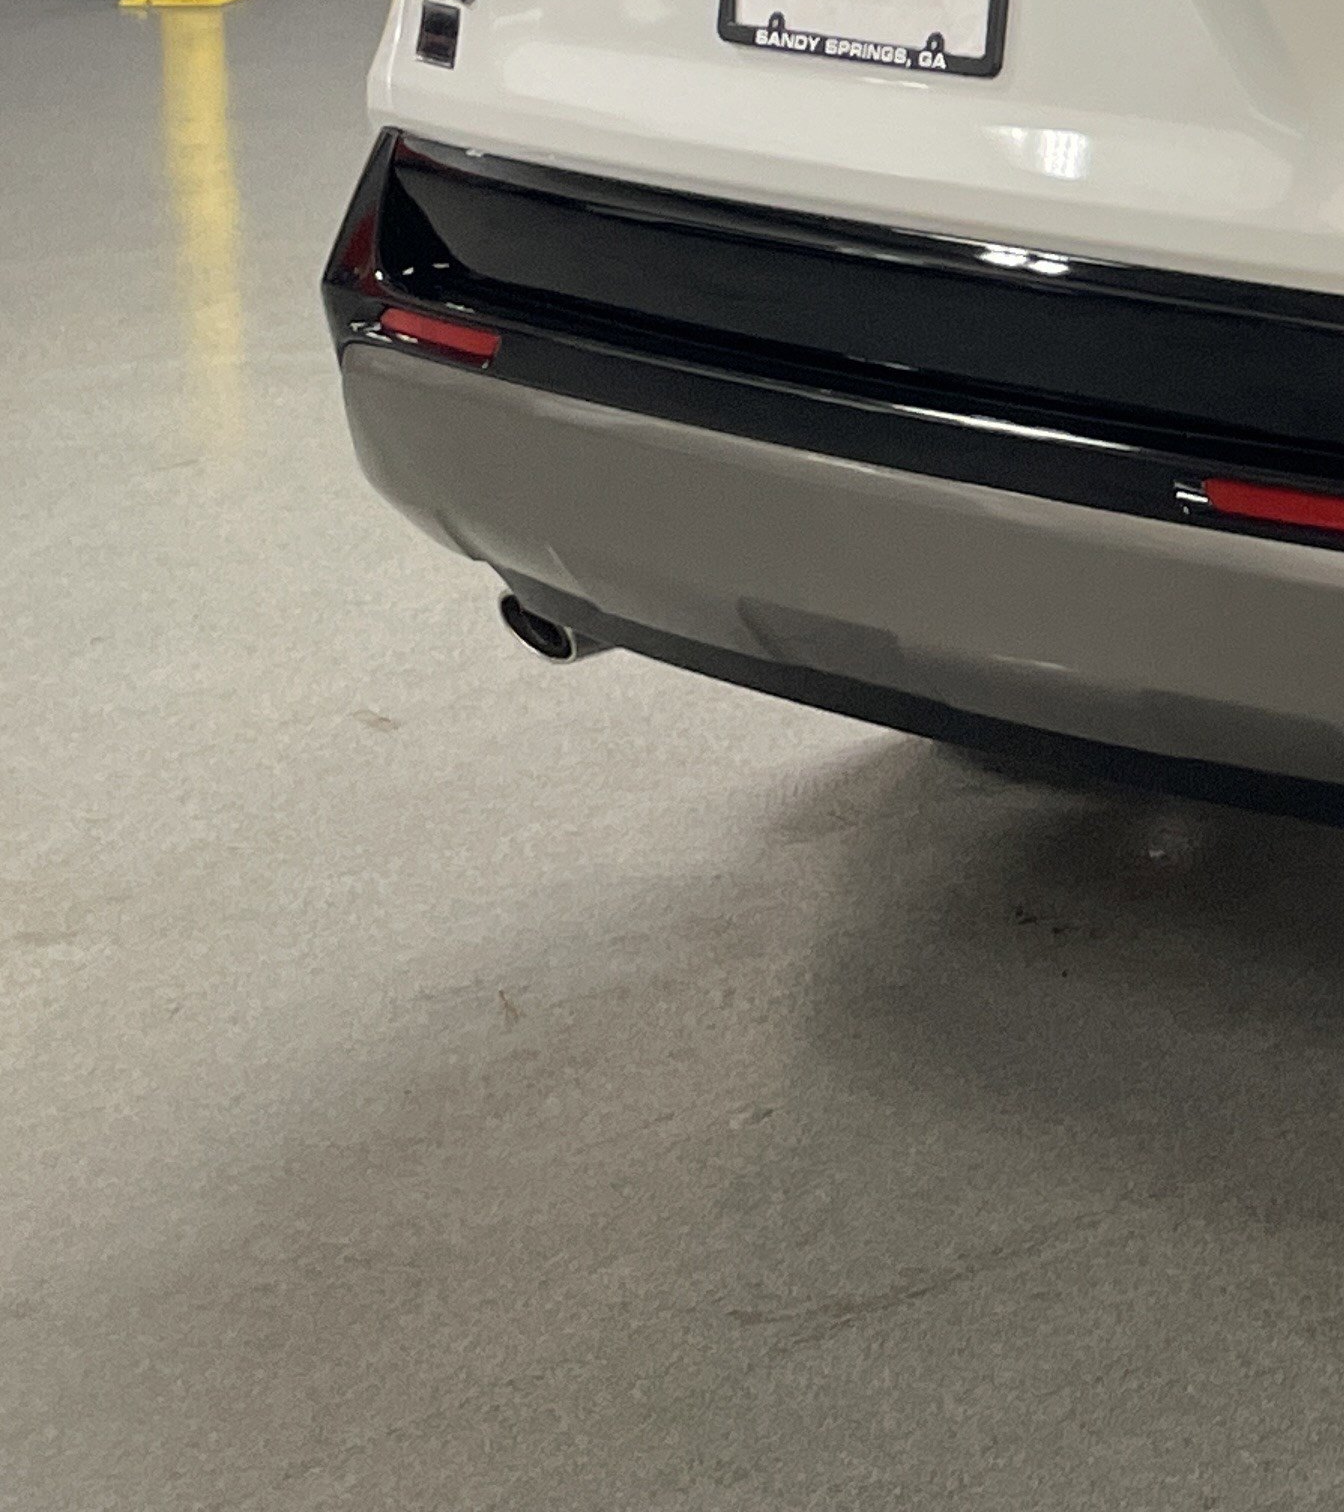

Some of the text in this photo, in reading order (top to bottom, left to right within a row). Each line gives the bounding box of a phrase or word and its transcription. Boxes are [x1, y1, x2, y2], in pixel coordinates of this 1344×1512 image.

[754, 28, 948, 71] SANDY SPRINGS, GA
